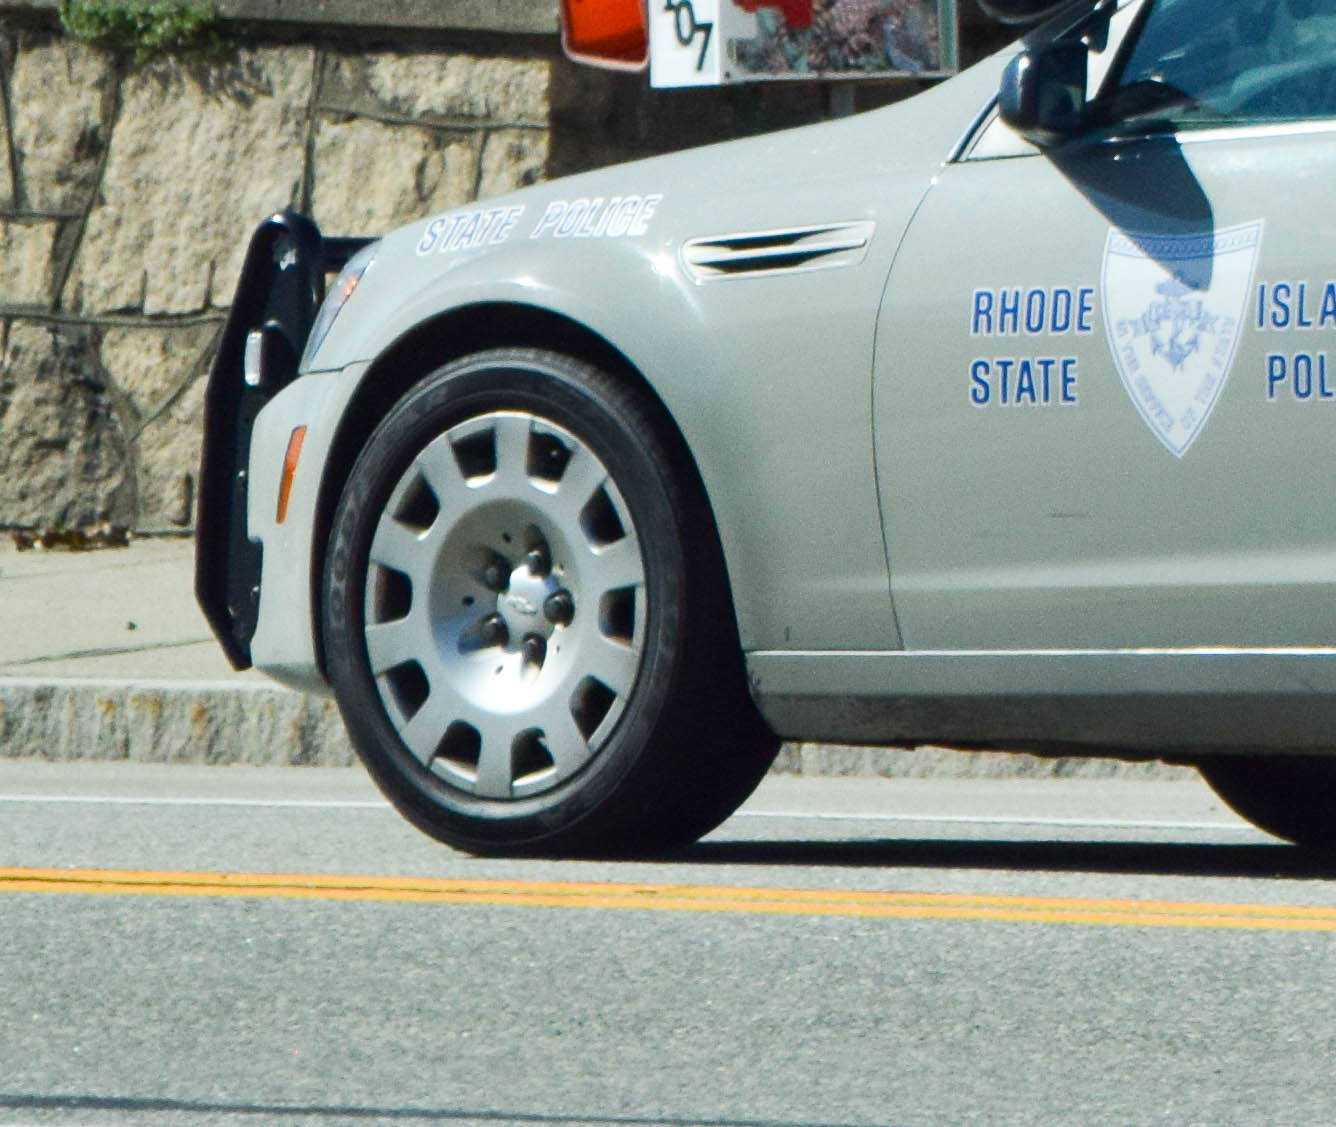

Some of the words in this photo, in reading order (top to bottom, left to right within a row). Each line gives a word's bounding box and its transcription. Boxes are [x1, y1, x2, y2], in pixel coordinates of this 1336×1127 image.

[416, 205, 525, 256] STATE
[529, 194, 663, 239] POLICE
[970, 287, 1095, 336] RHODE
[969, 357, 1079, 406] STATE
